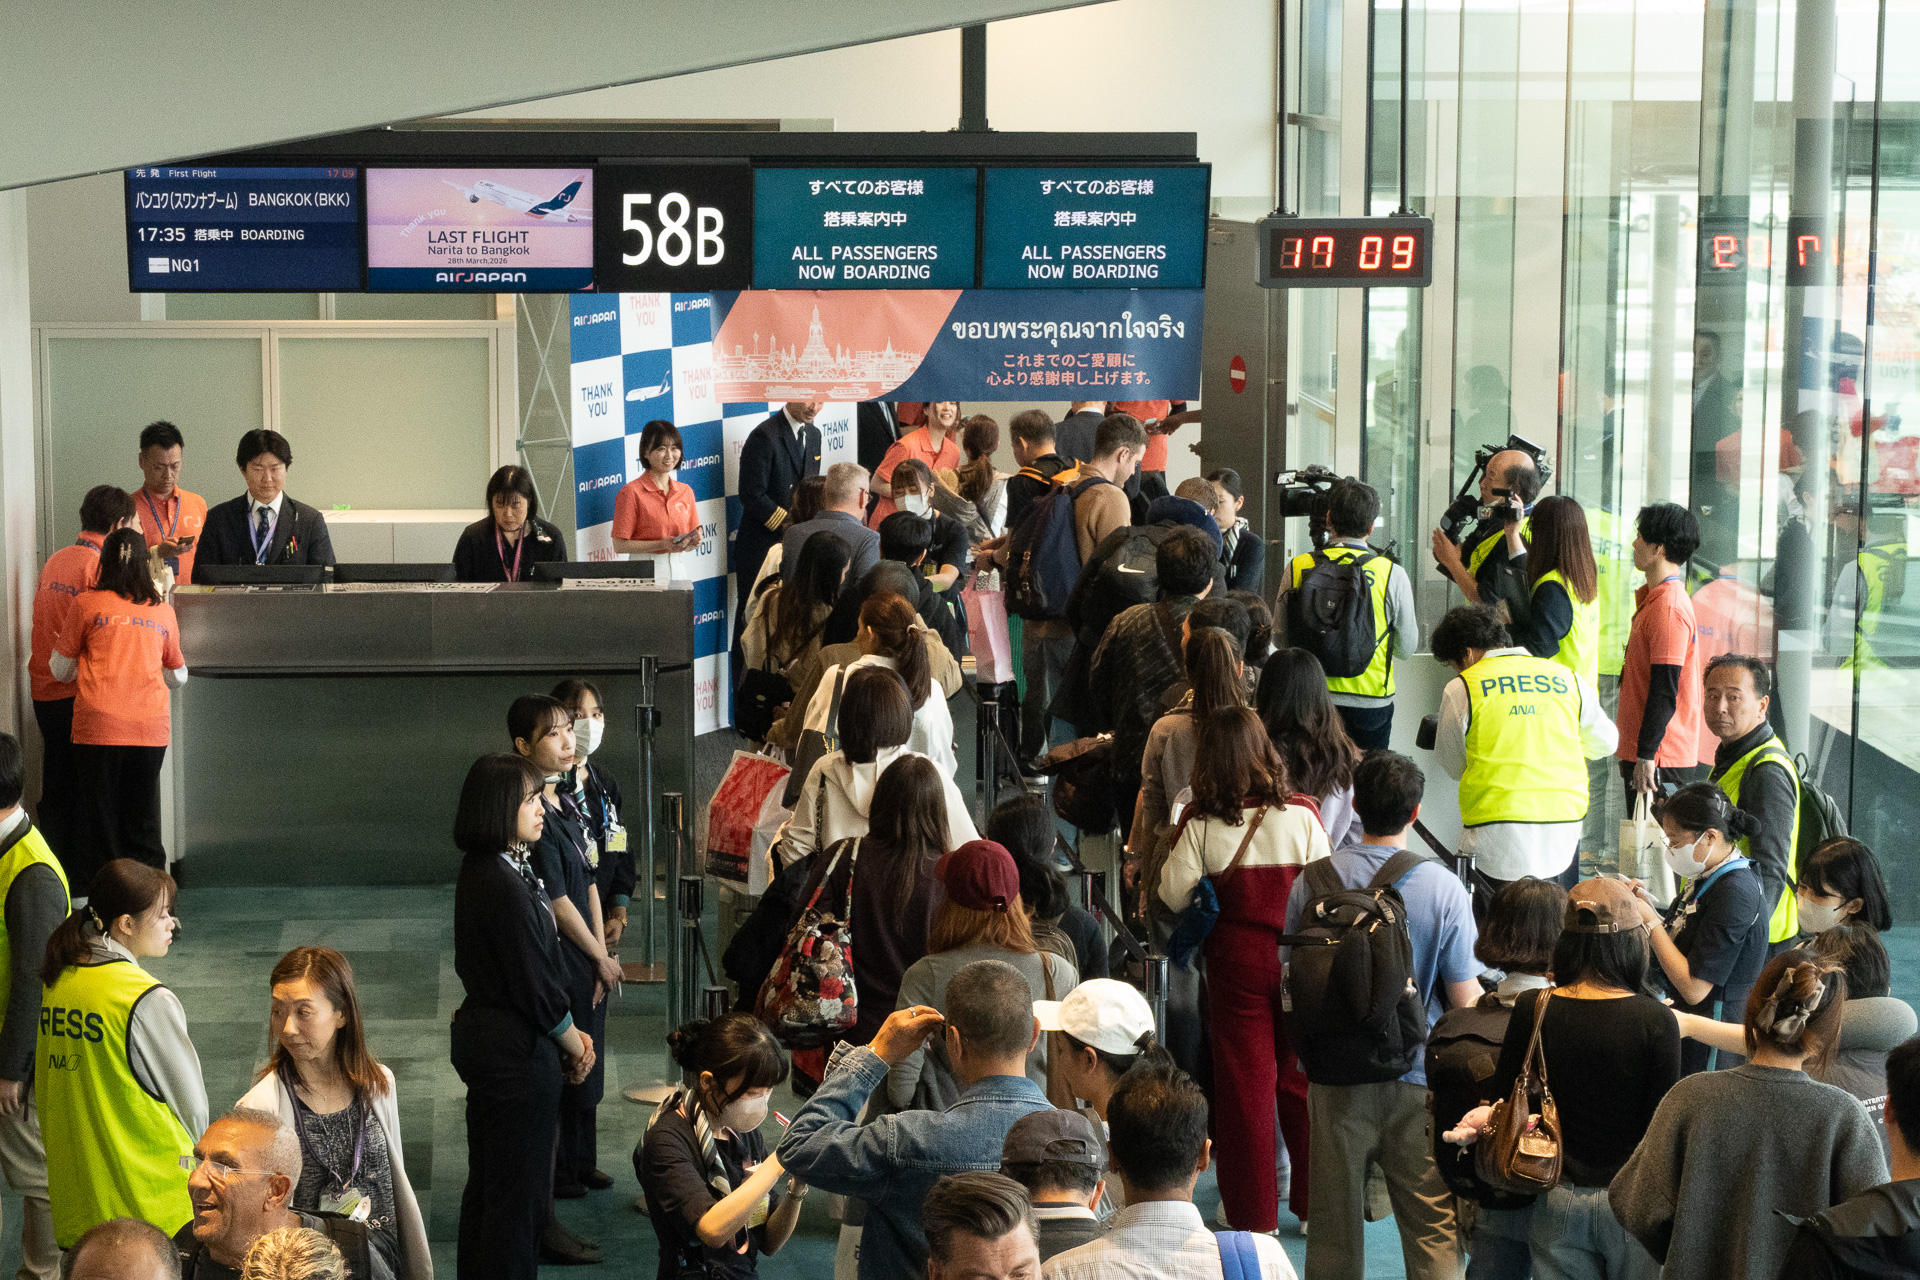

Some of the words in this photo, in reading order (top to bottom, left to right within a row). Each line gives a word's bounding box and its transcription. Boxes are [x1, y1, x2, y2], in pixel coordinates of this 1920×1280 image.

[168, 169, 189, 178] First
[192, 169, 217, 178] Flight
[327, 169, 339, 178] 17
[341, 169, 355, 178] 09
[809, 179, 925, 196] すべてのお客様
[1040, 179, 1154, 196] すべてのお客様
[823, 211, 907, 227] 搭乗案内中
[1053, 211, 1137, 227] 搭乗案内中
[137, 227, 186, 242] 17:35
[194, 228, 234, 241] 搭乗中
[240, 229, 305, 241] BOARDING
[428, 230, 467, 243] LAST
[473, 230, 529, 243] FLIGHT
[622, 192, 725, 267] 58B
[428, 245, 463, 255] Narita
[466, 245, 478, 255] to
[481, 245, 530, 257] Bangkok
[792, 245, 823, 260] ALL
[832, 245, 938, 260] PASSENGERS
[1021, 245, 1052, 260] ALL
[1061, 245, 1167, 260] PASSENGERS
[1293, 236, 1335, 269] 17
[1358, 236, 1416, 270] 09
[171, 258, 199, 272] NQ1
[798, 265, 835, 279] NOW
[844, 265, 931, 279] BOARDING
[1028, 264, 1065, 279] NOW
[1072, 264, 1159, 279] BOARDING
[636, 311, 656, 327] YOU
[951, 311, 1185, 348] ขอบพระคุณจากใจจริง
[1003, 353, 1135, 368] これまでのご愛顧に
[986, 371, 1152, 386] 心より感謝申し上げます。
[581, 382, 613, 401] THANK
[688, 385, 707, 401] YOU
[588, 401, 608, 418] YOU
[822, 419, 849, 437] THANK
[827, 436, 844, 451] YOU
[700, 522, 718, 538] ANK
[694, 677, 720, 697] HANK
[1480, 674, 1568, 698] PRESS
[696, 695, 714, 713] YOU
[1508, 704, 1536, 717] ANA
[39, 1006, 104, 1043] RESS
[48, 1054, 67, 1070] NA
